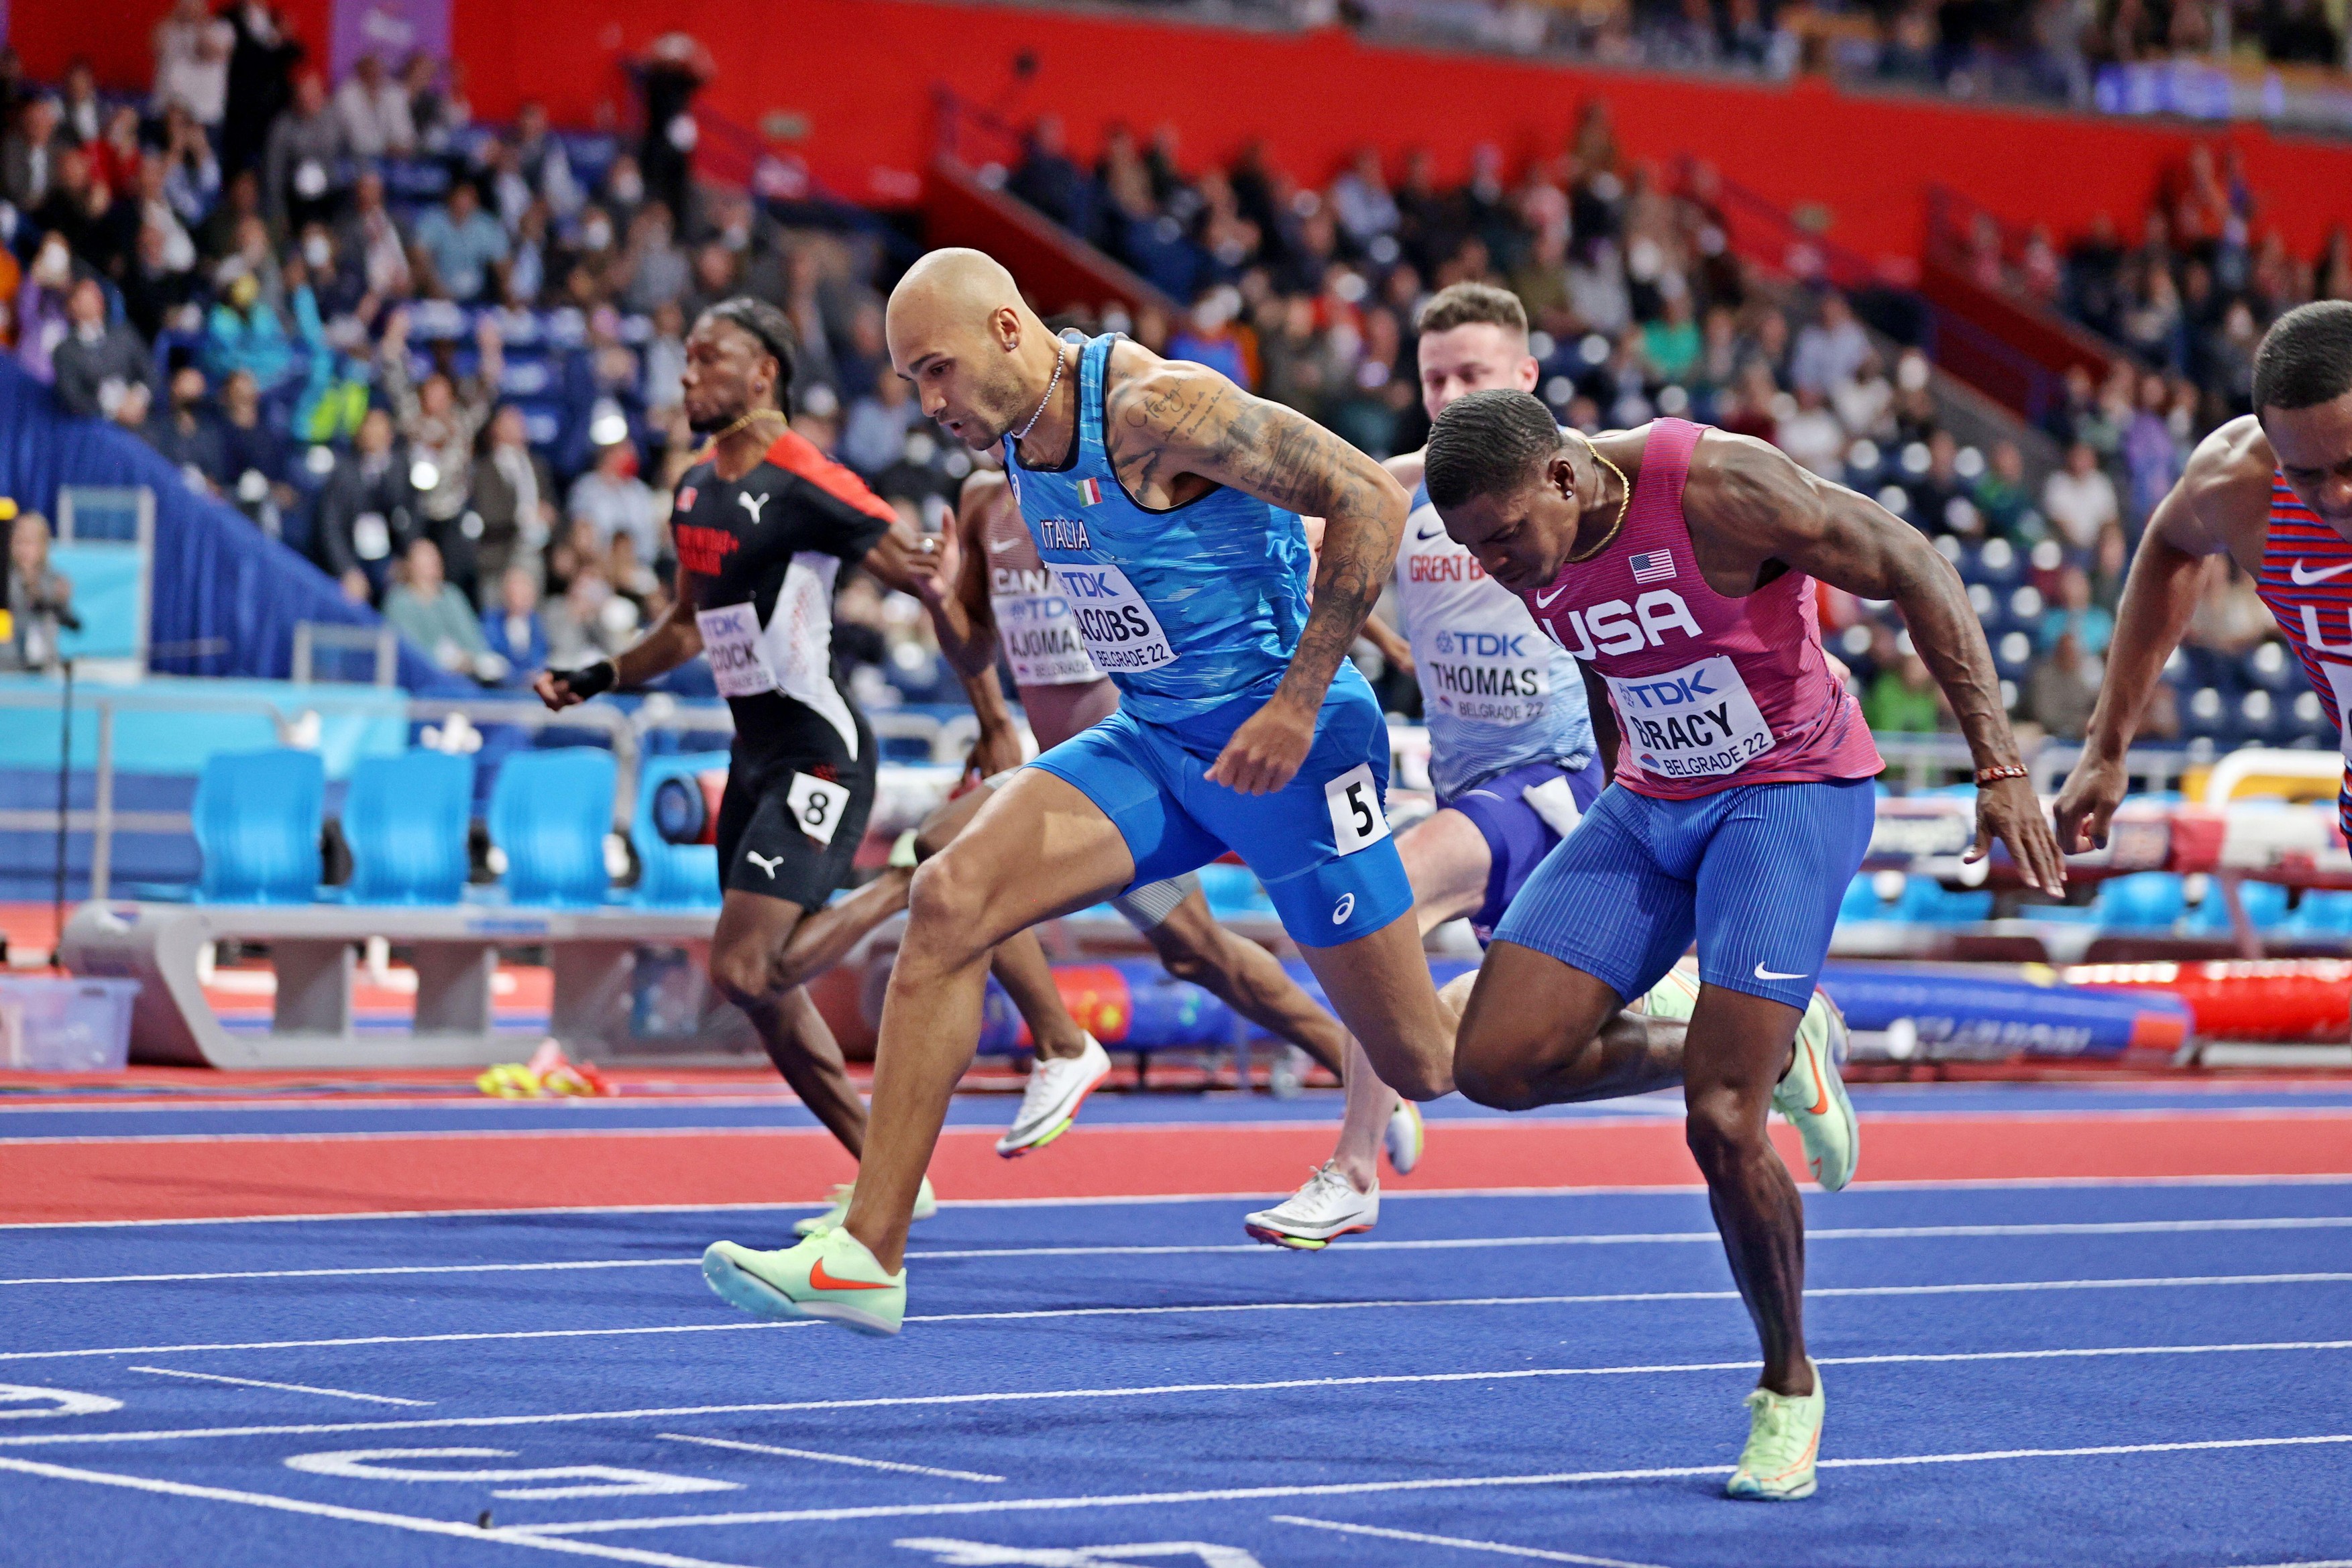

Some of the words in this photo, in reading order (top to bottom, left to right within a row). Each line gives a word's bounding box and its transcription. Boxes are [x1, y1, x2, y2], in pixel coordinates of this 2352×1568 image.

[1040, 519, 1091, 550] ITALIA
[995, 569, 1052, 592] CAN
[1410, 555, 1463, 582] GREAT
[1062, 572, 1120, 598] TDK
[1025, 596, 1072, 619] TD
[1072, 605, 1150, 642] ACOBS
[1541, 588, 1704, 661] USA
[1096, 648, 1149, 667] BELGRADE
[1146, 643, 1169, 663] 22
[1454, 633, 1527, 657] TDK
[1430, 661, 1538, 697] THOMAS
[1626, 668, 1718, 708] TDK
[1459, 702, 1521, 720] BELGRADE
[1526, 702, 1544, 718] 22
[1630, 702, 1734, 750] BRACY
[1663, 746, 1744, 776] BELGRADE
[1744, 732, 1769, 756] 22
[805, 793, 828, 826] 8
[1345, 781, 1374, 838] 5
